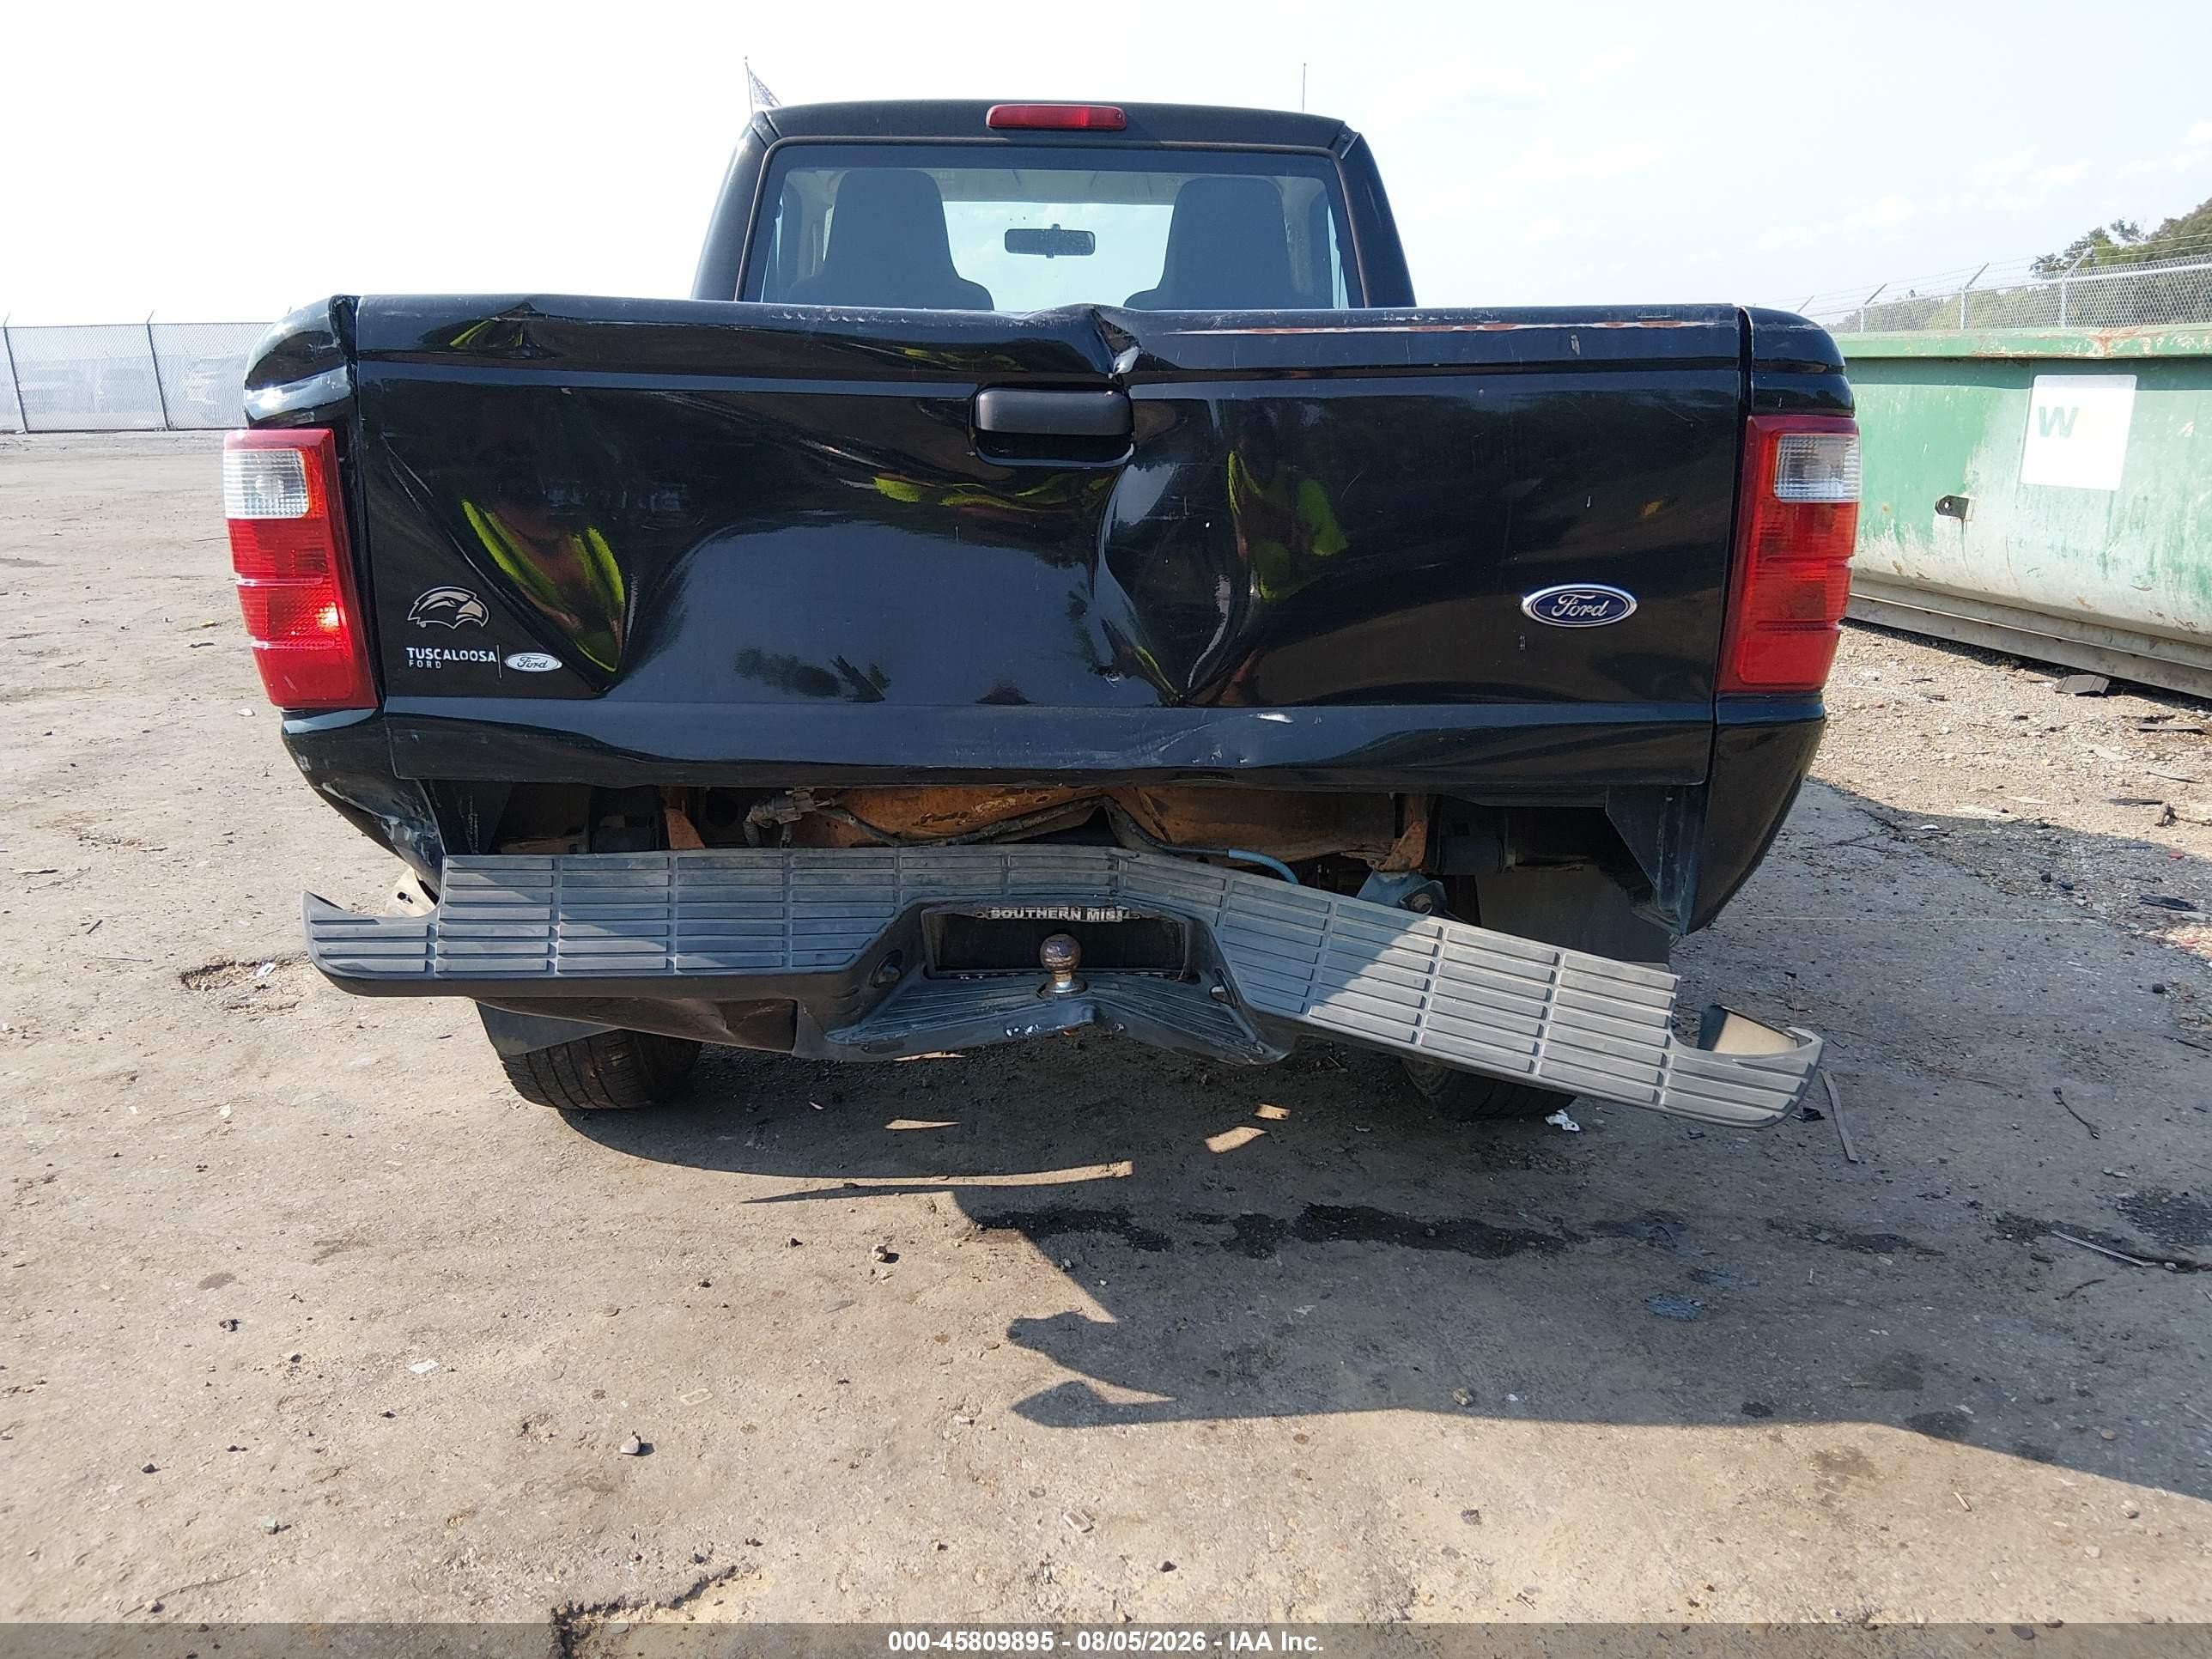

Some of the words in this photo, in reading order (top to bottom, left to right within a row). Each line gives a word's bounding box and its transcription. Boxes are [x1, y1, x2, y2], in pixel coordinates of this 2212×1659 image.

[1551, 593, 1610, 617] Ford
[406, 647, 497, 663] TUSCALOOSA
[408, 659, 442, 670] FORD
[517, 656, 549, 669] Ford
[989, 907, 1082, 921] SOUTHERN
